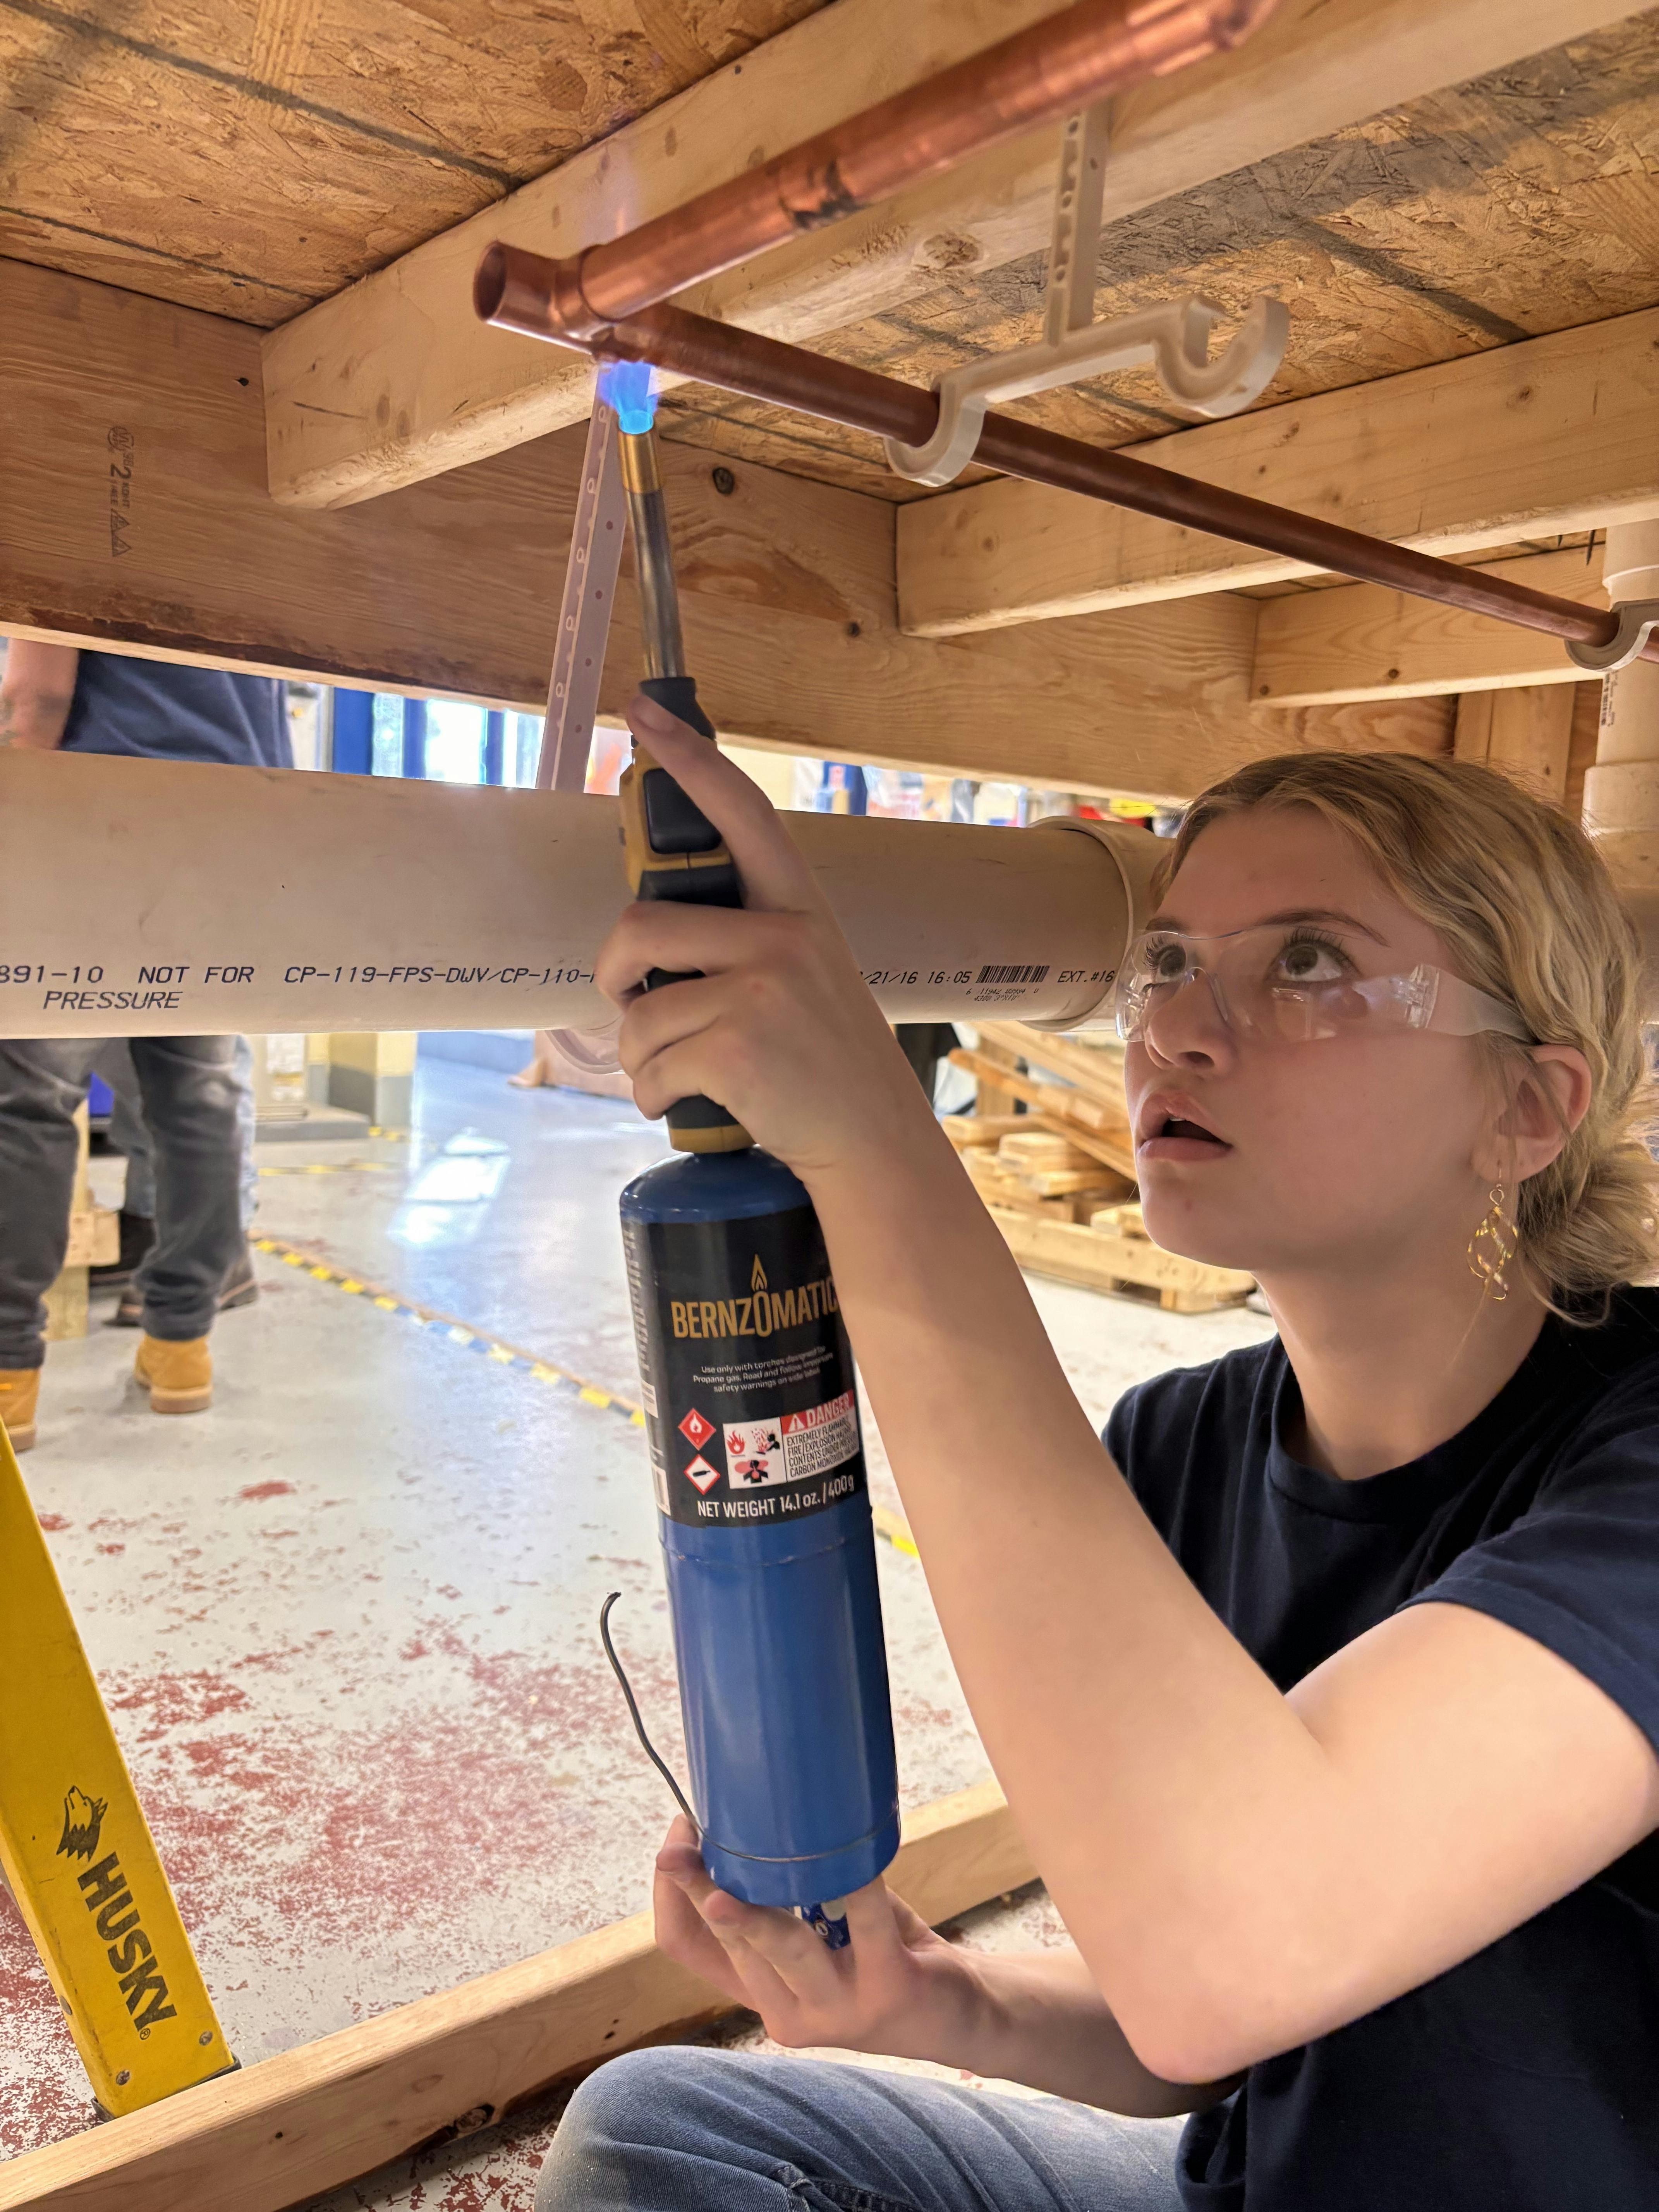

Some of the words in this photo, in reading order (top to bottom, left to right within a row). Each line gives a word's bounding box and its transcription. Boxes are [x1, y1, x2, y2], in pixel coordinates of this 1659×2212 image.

[110, 463, 132, 480] 2
[138, 966, 190, 984] NOT
[204, 966, 255, 984] FOR
[860, 970, 918, 986] /21/16
[927, 971, 972, 984] 16:05
[43, 991, 183, 1010] PRESSURE
[716, 1364, 733, 1374] only
[735, 1362, 753, 1372] with
[754, 1358, 785, 1370] torches
[693, 1375, 724, 1384] Propane
[743, 1370, 763, 1381] Read
[763, 1368, 778, 1377] and
[713, 1383, 739, 1393] safety
[740, 1379, 776, 1391] warnings
[805, 1392, 849, 1428] DANGER
[786, 1427, 822, 1446] EXTREMELY
[787, 1434, 835, 1457] FIRE/EXPLOSION
[788, 1449, 822, 1467] CONTENTS
[790, 1462, 816, 1478] CARBON
[697, 1500, 720, 1518] NET
[723, 1498, 776, 1518] WEIGHT
[77, 1851, 177, 2033] HUSKY
